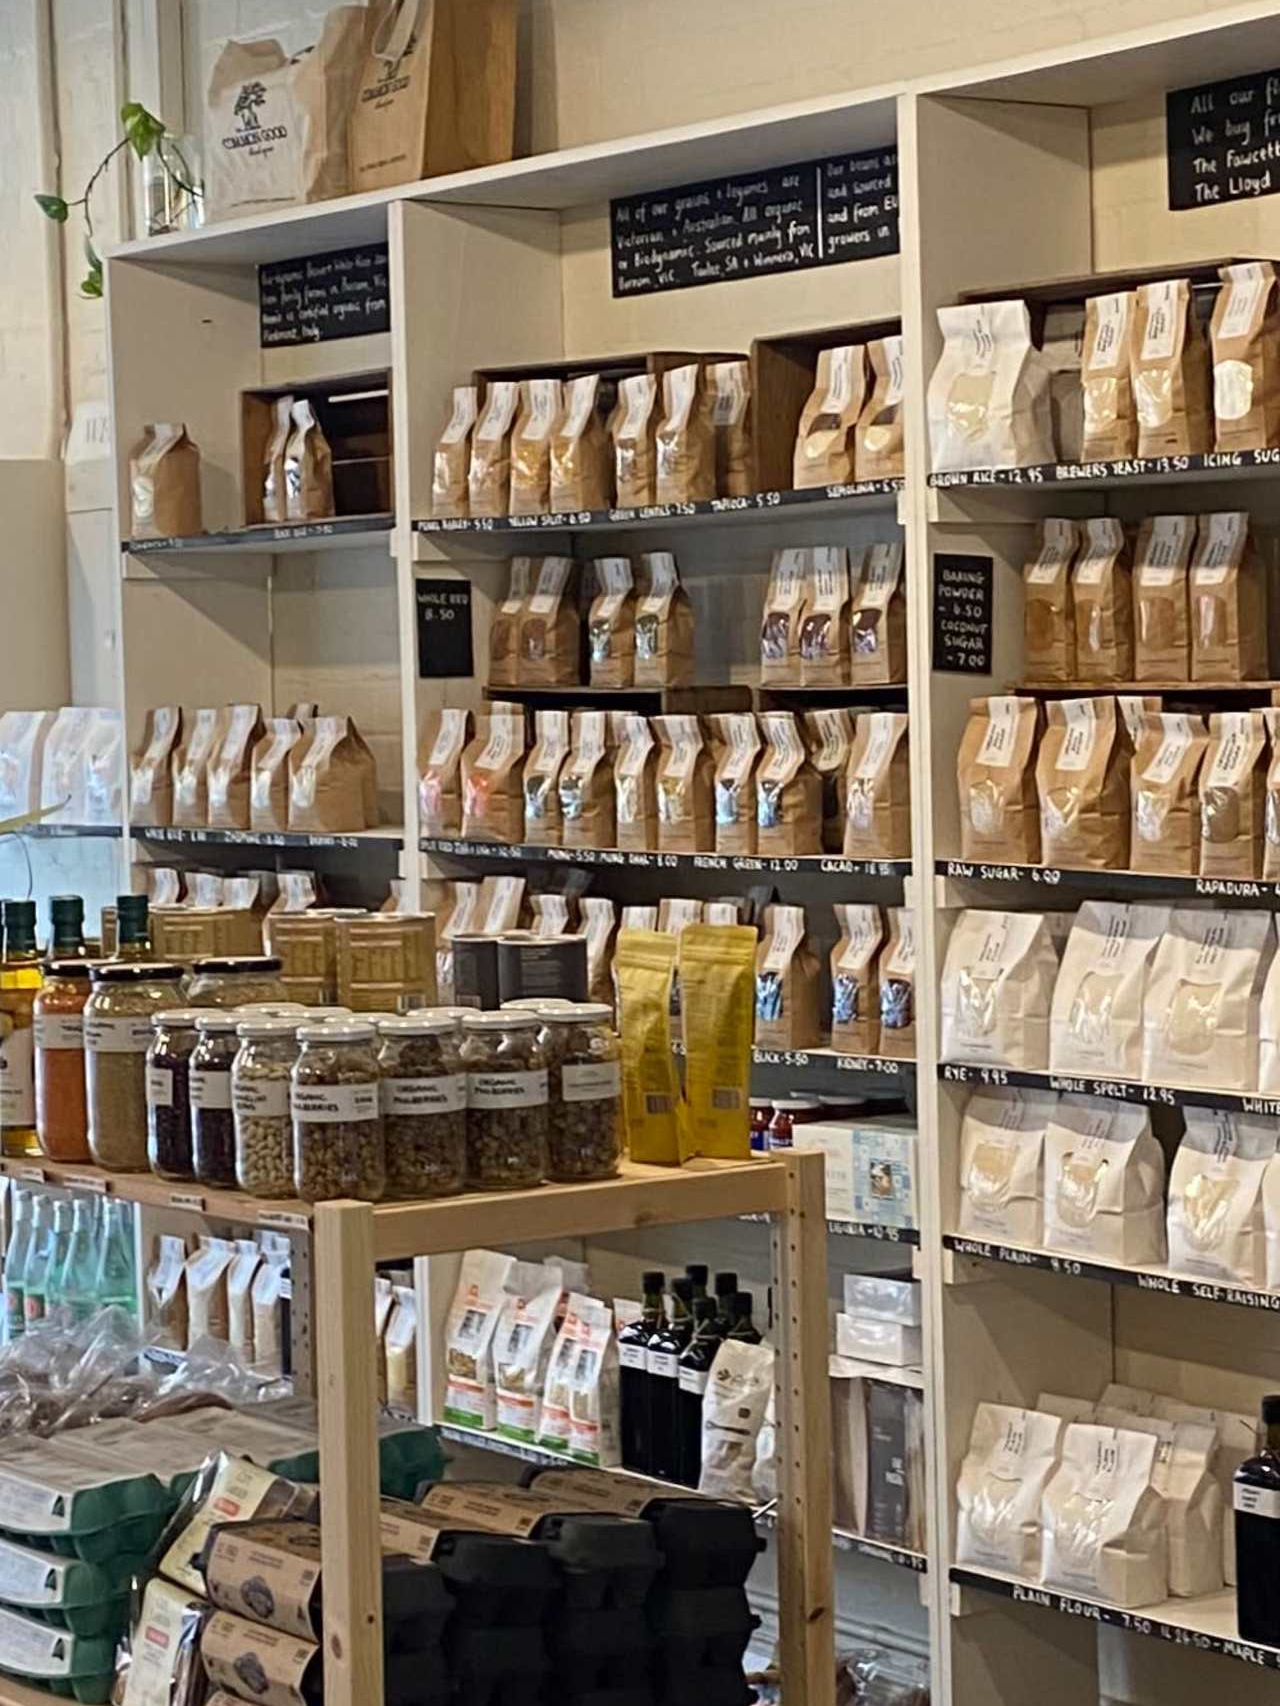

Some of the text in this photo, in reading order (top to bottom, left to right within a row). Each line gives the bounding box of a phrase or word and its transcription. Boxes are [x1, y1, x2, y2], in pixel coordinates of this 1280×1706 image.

[1190, 94, 1215, 114] All
[1229, 89, 1253, 105] our
[1191, 126, 1214, 144] We
[1225, 119, 1252, 145] buy
[1193, 157, 1217, 174] The
[1195, 182, 1221, 203] The
[1228, 169, 1271, 195] Lloyd
[787, 220, 811, 244] from
[1203, 451, 1242, 467] ICING
[928, 474, 968, 488] BROWN
[1055, 465, 1108, 481] BREWERS
[942, 568, 985, 586] BAKING
[938, 584, 985, 601] POWDER
[941, 618, 989, 635] COCONUT
[943, 635, 985, 651] SUGAR
[947, 862, 974, 878] RAW
[1049, 1077, 1086, 1093] WHOLE
[953, 1239, 992, 1258] WHOLE
[1138, 1272, 1182, 1295] WHOLE
[1012, 1584, 1051, 1608] PLAIN
[1222, 1639, 1266, 1666] MAPLE
